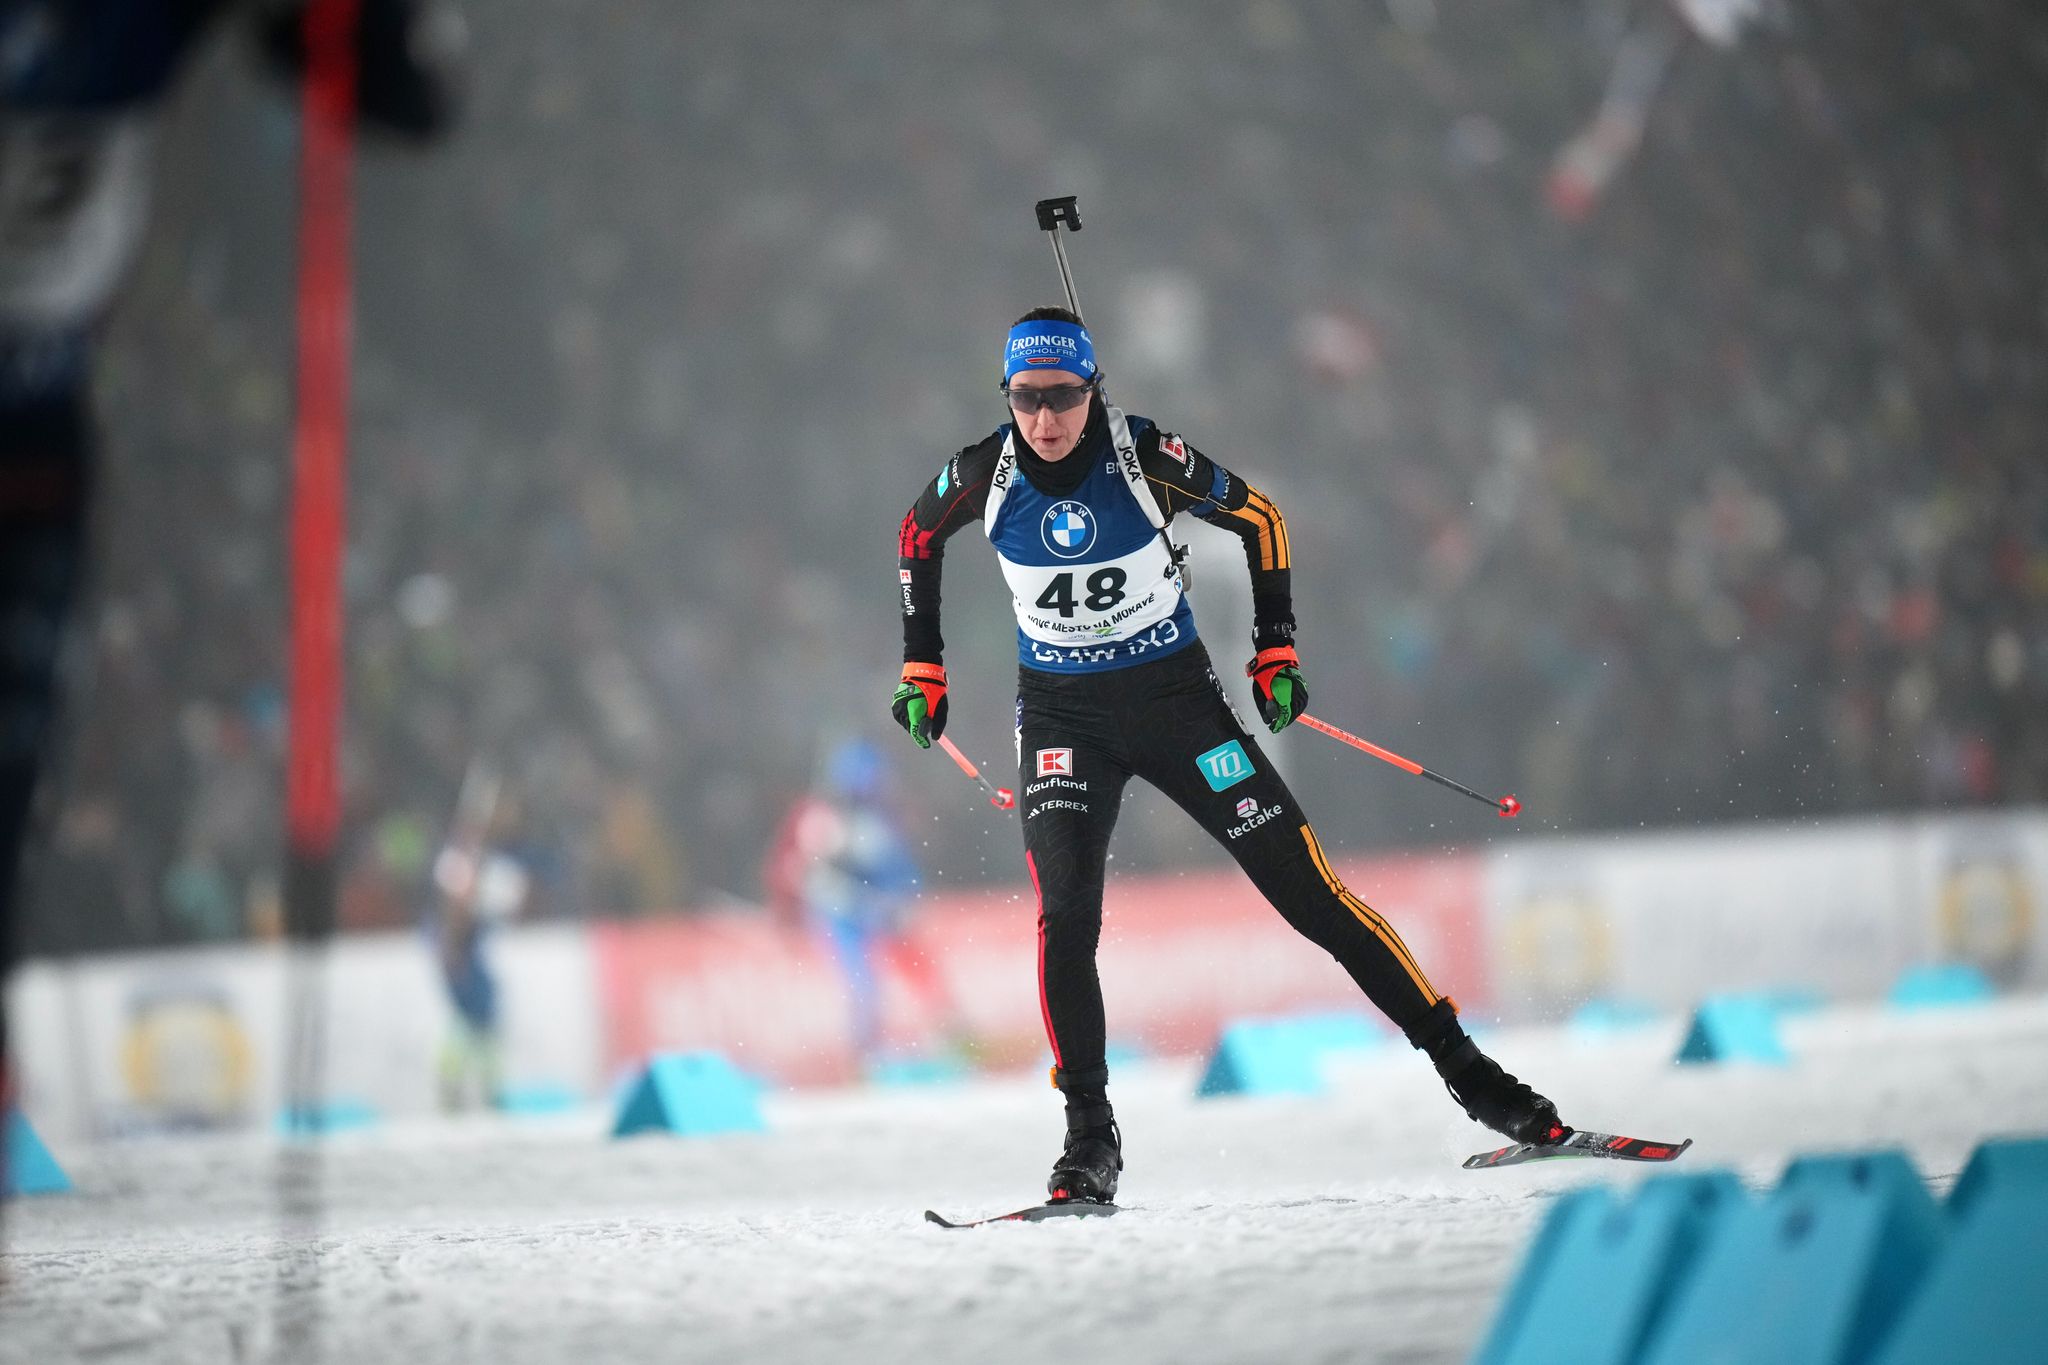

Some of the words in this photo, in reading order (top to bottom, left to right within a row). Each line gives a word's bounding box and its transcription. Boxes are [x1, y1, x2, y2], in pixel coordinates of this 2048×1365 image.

[1010, 347, 1077, 360] ALKOHOLFREI
[1011, 335, 1078, 352] ERDINGER
[993, 454, 1015, 492] JOKA
[1118, 446, 1141, 483] JOKA
[1048, 503, 1088, 521] BMW
[902, 585, 916, 616] Kaufl
[1035, 566, 1128, 619] 48
[1203, 749, 1249, 779] TQ
[1026, 777, 1088, 797] Kaufland
[1039, 800, 1089, 813] TERREX
[1226, 803, 1283, 839] tectake
